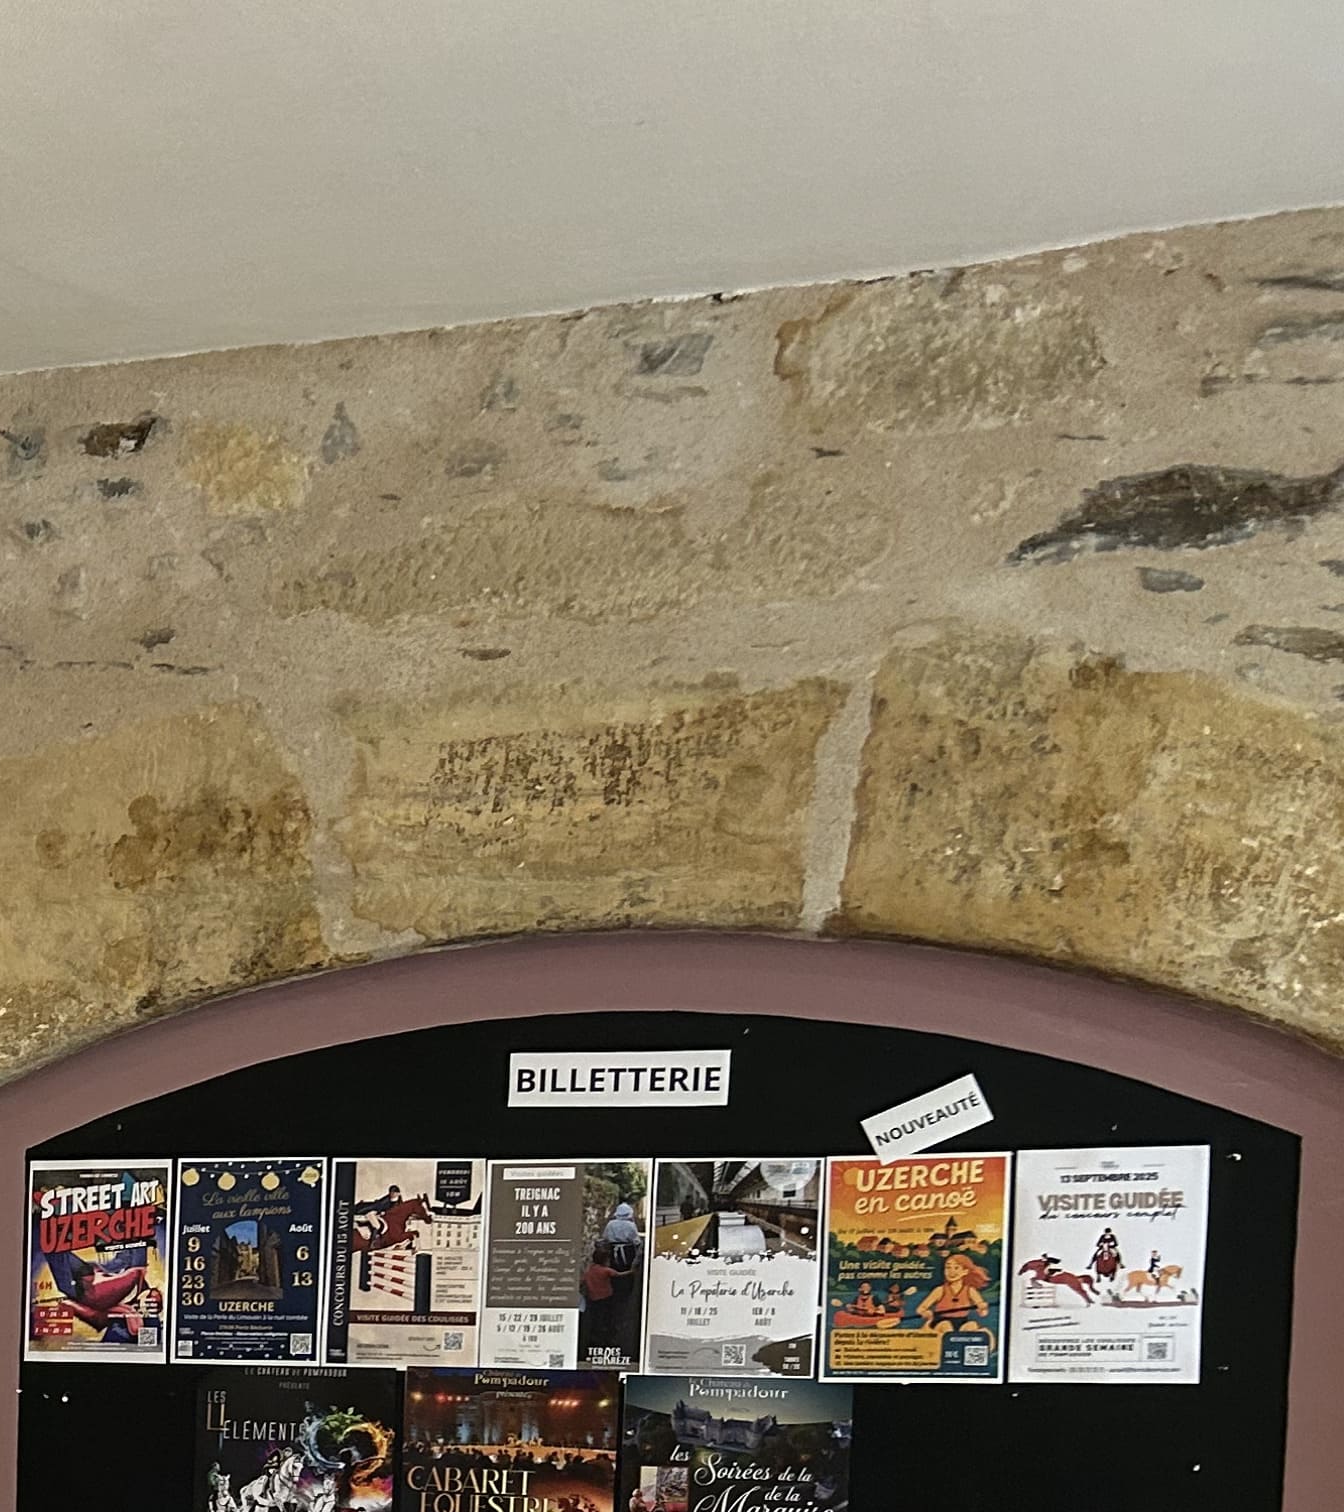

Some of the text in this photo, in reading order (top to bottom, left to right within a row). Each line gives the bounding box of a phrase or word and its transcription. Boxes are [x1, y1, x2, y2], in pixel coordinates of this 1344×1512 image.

[516, 1067, 722, 1093] BILLETTERIE
[875, 1091, 980, 1147] NOUVEAUTÉ
[856, 1159, 985, 1193] UZERCHE
[1072, 1173, 1131, 1183] SEPTEMBRE
[1133, 1172, 1159, 1181] 2025
[40, 1180, 159, 1220] STREET ART
[515, 1188, 560, 1201] TREIGNAC
[854, 1186, 977, 1215] en canoë
[1038, 1187, 1185, 1211] VISITE GUIDÉE
[238, 1203, 292, 1220] lampions
[522, 1205, 549, 1218] IL Y A
[40, 1206, 156, 1254] UZERCHE
[182, 1224, 210, 1235] Juillet
[289, 1223, 312, 1233] Août
[515, 1221, 556, 1234] 200 ANS
[188, 1237, 201, 1252] 9
[296, 1246, 309, 1261] 6
[184, 1256, 206, 1271] 16
[332, 1200, 351, 1326] CONCOURS DU 15 AOÛT
[182, 1274, 205, 1290] 23
[292, 1272, 312, 1286] 13
[838, 1272, 855, 1282] pas
[890, 1271, 902, 1279] les
[182, 1292, 205, 1306] 30
[219, 1301, 274, 1312] UZERCHE
[357, 1314, 469, 1324] VISITE GUIDÉE DES COULISSES
[474, 1373, 550, 1387] Pompadour
[207, 1391, 227, 1404] LES
[689, 1384, 789, 1400] Pompadour
[670, 1445, 690, 1462] les
[693, 1452, 812, 1484] Soirées de la
[407, 1466, 536, 1495] CABARET
[764, 1486, 801, 1501] de la
